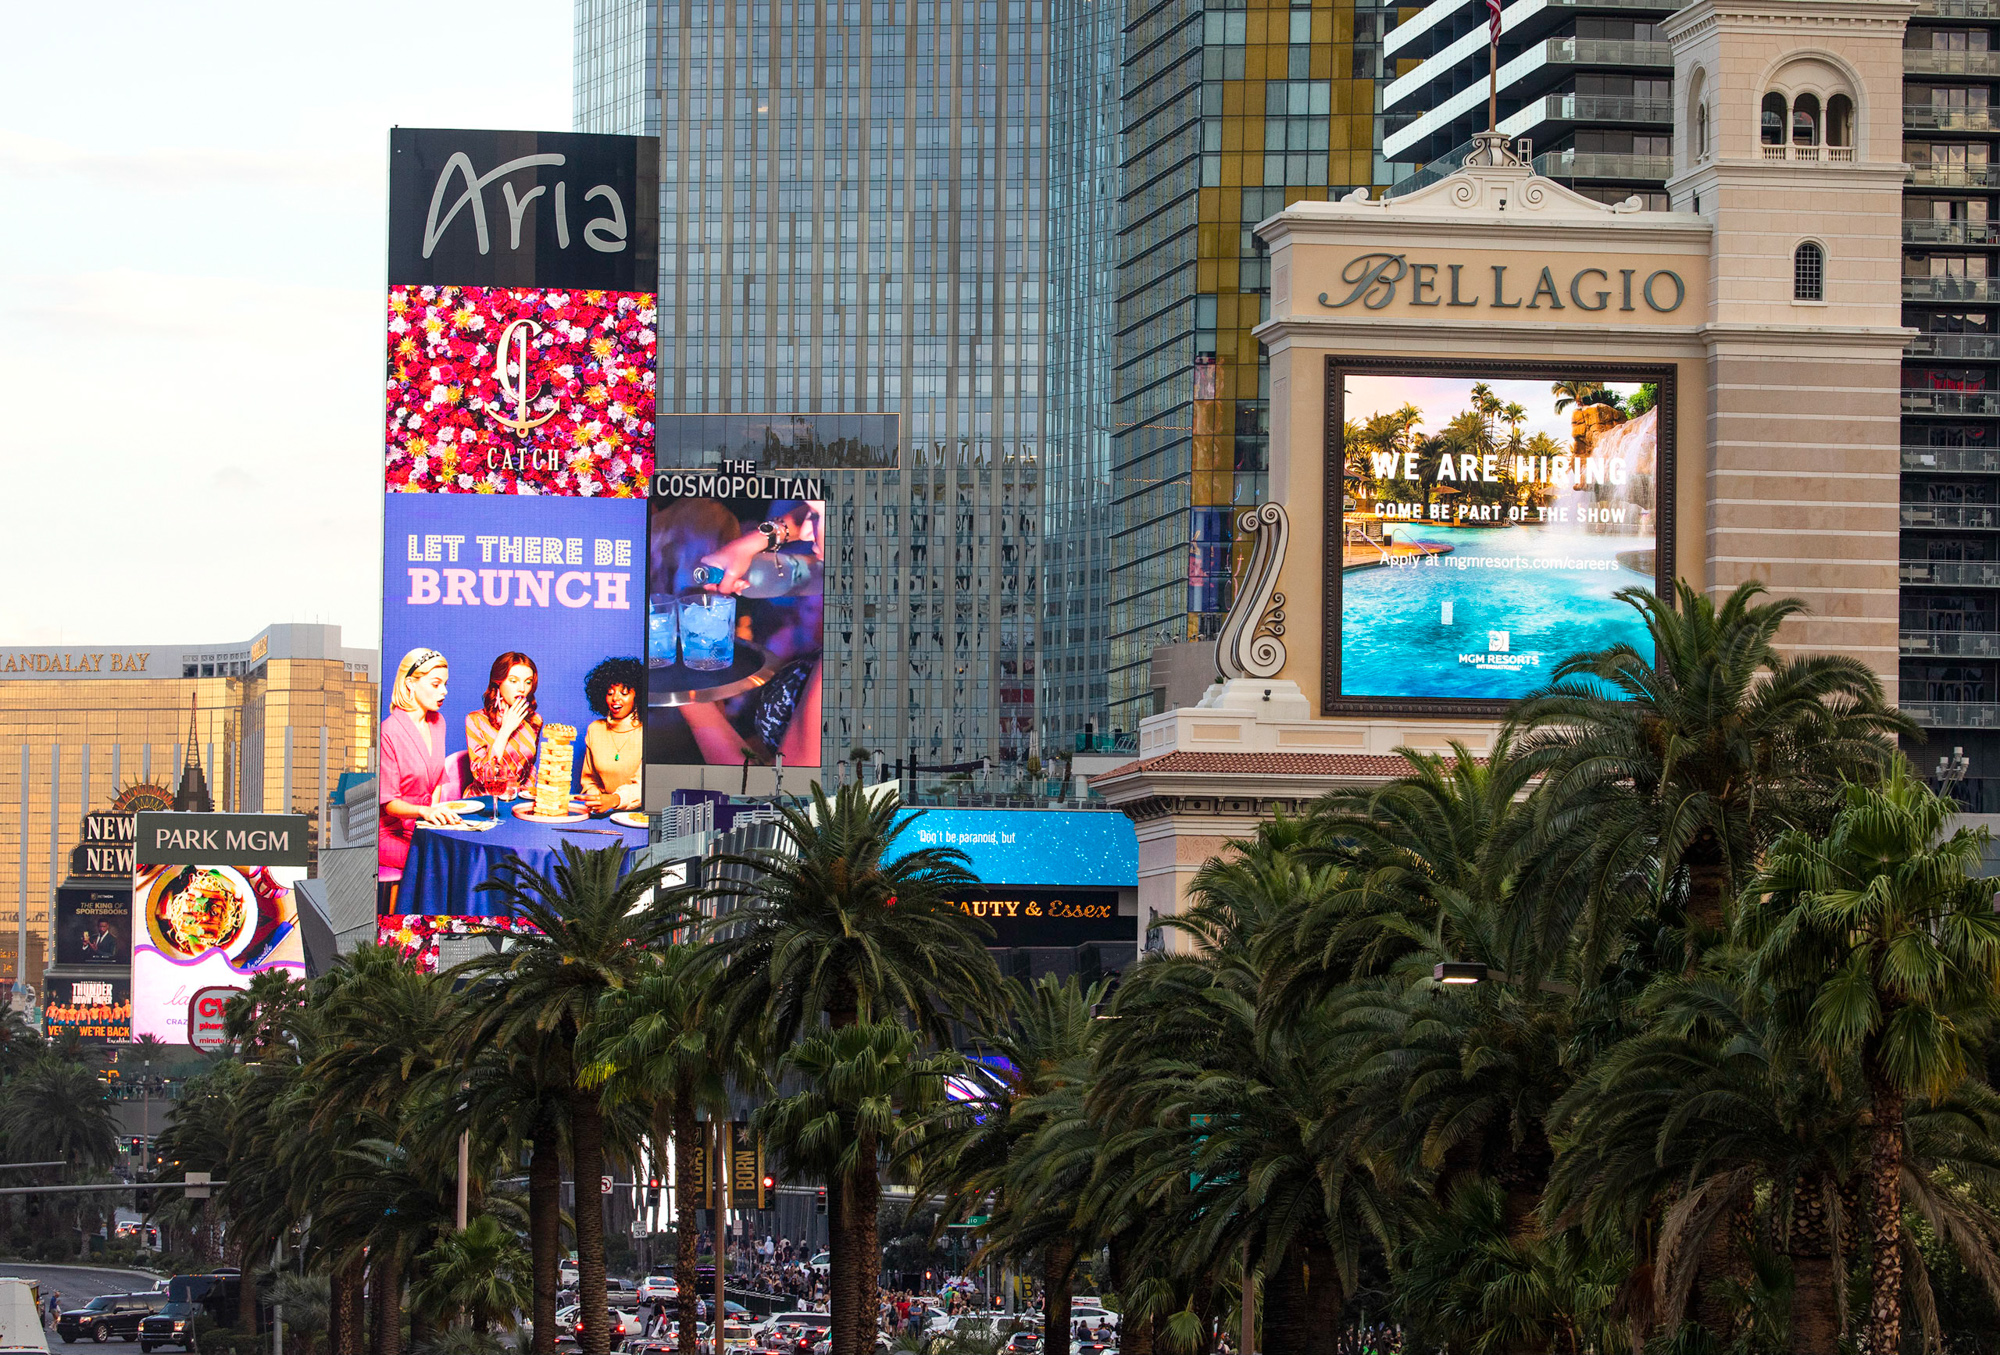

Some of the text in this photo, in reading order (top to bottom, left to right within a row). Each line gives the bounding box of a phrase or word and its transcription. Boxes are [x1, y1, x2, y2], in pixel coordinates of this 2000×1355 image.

[422, 151, 628, 259] Aria
[1318, 252, 1685, 312] BELLAGIO
[487, 447, 560, 471] CATCH
[723, 459, 755, 474] THE
[1371, 451, 1627, 486] WE ARE HIRING
[656, 475, 821, 500] COSMOPOLITAN
[1374, 502, 1626, 523] COME BE PART OF THE SHOW
[407, 534, 631, 566] LET THERE BE
[1380, 552, 1619, 571] Apply at mgmresorts.com/careers
[407, 567, 631, 610] BRUNCH
[0, 652, 150, 672] ANDALAY BAY
[1458, 653, 1539, 665] MGM RESORTS
[87, 816, 135, 840] NEW
[945, 830, 957, 842] be
[1002, 831, 1016, 843] but
[156, 828, 289, 851] PARK MGM
[1025, 901, 1043, 917] &
[1048, 899, 1112, 919] Essex
[72, 983, 113, 996] THUNDER
[198, 997, 231, 1018] CV
[80, 1025, 106, 1037] WE'RE
[107, 1026, 130, 1037] BACK
[735, 1150, 755, 1190] BORN
[635, 1229, 647, 1237] 30
